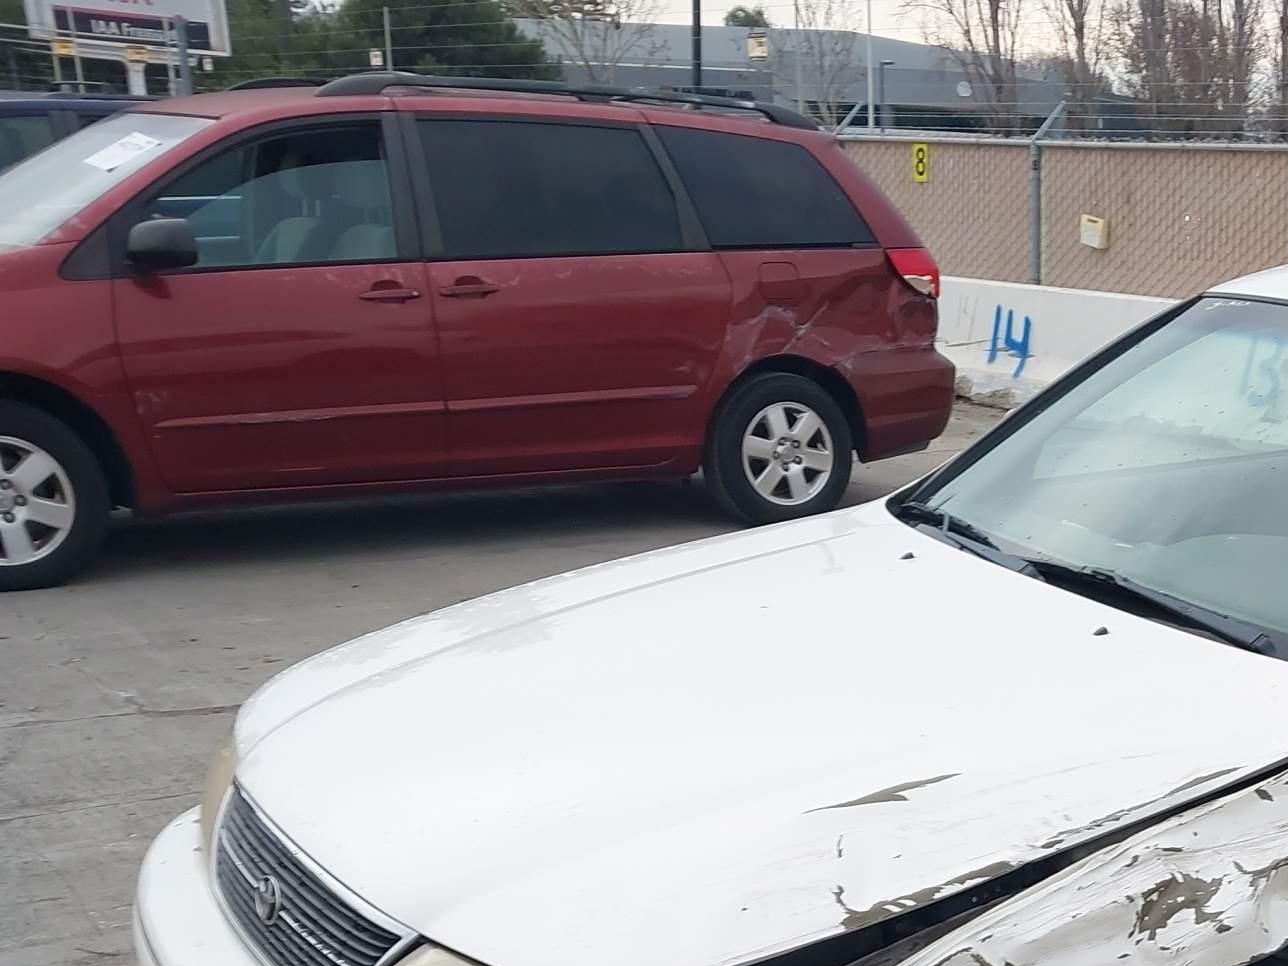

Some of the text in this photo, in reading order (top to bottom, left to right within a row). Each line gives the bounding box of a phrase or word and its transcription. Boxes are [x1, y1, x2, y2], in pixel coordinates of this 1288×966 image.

[91, 18, 120, 36] IAA
[915, 147, 926, 177] 8
[987, 304, 1032, 379] 14
